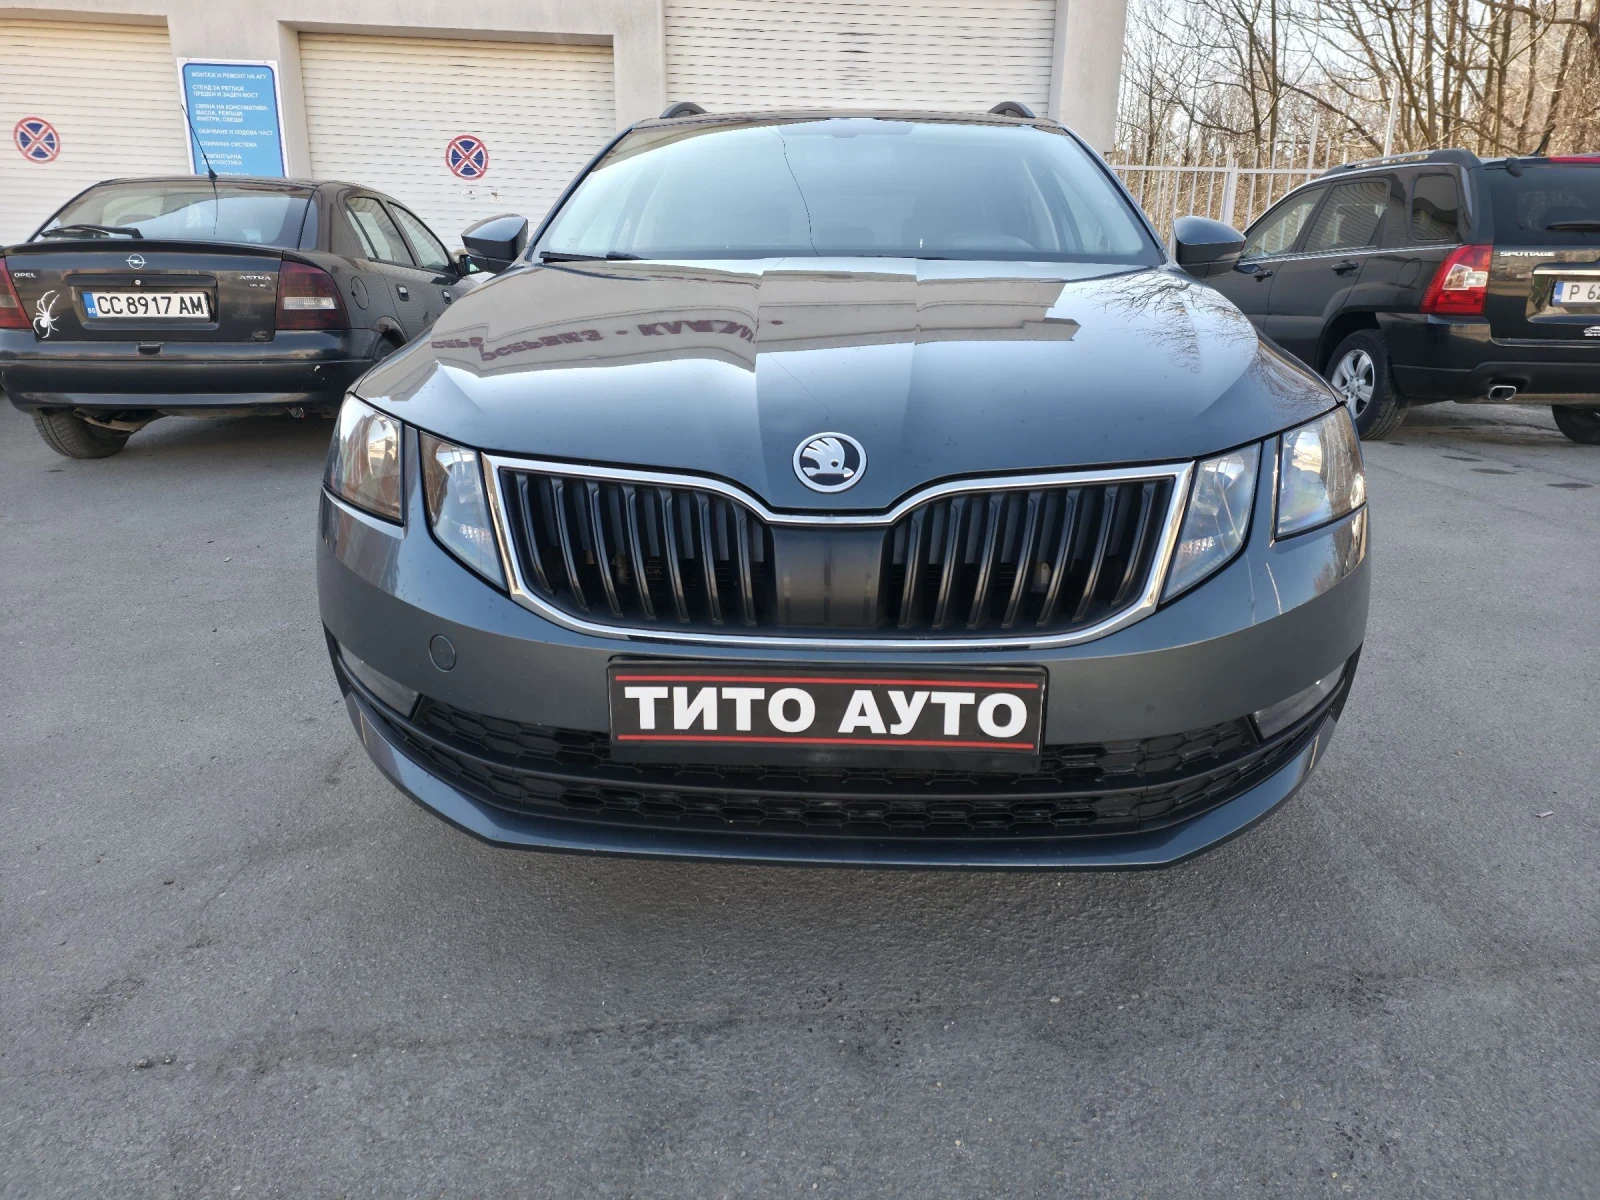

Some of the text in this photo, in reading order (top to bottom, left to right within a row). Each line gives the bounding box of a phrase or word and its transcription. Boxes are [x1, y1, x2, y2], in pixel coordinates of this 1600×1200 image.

[97, 296, 205, 314] CC 8917 AM
[624, 686, 1027, 738] ТИТО АУТО
